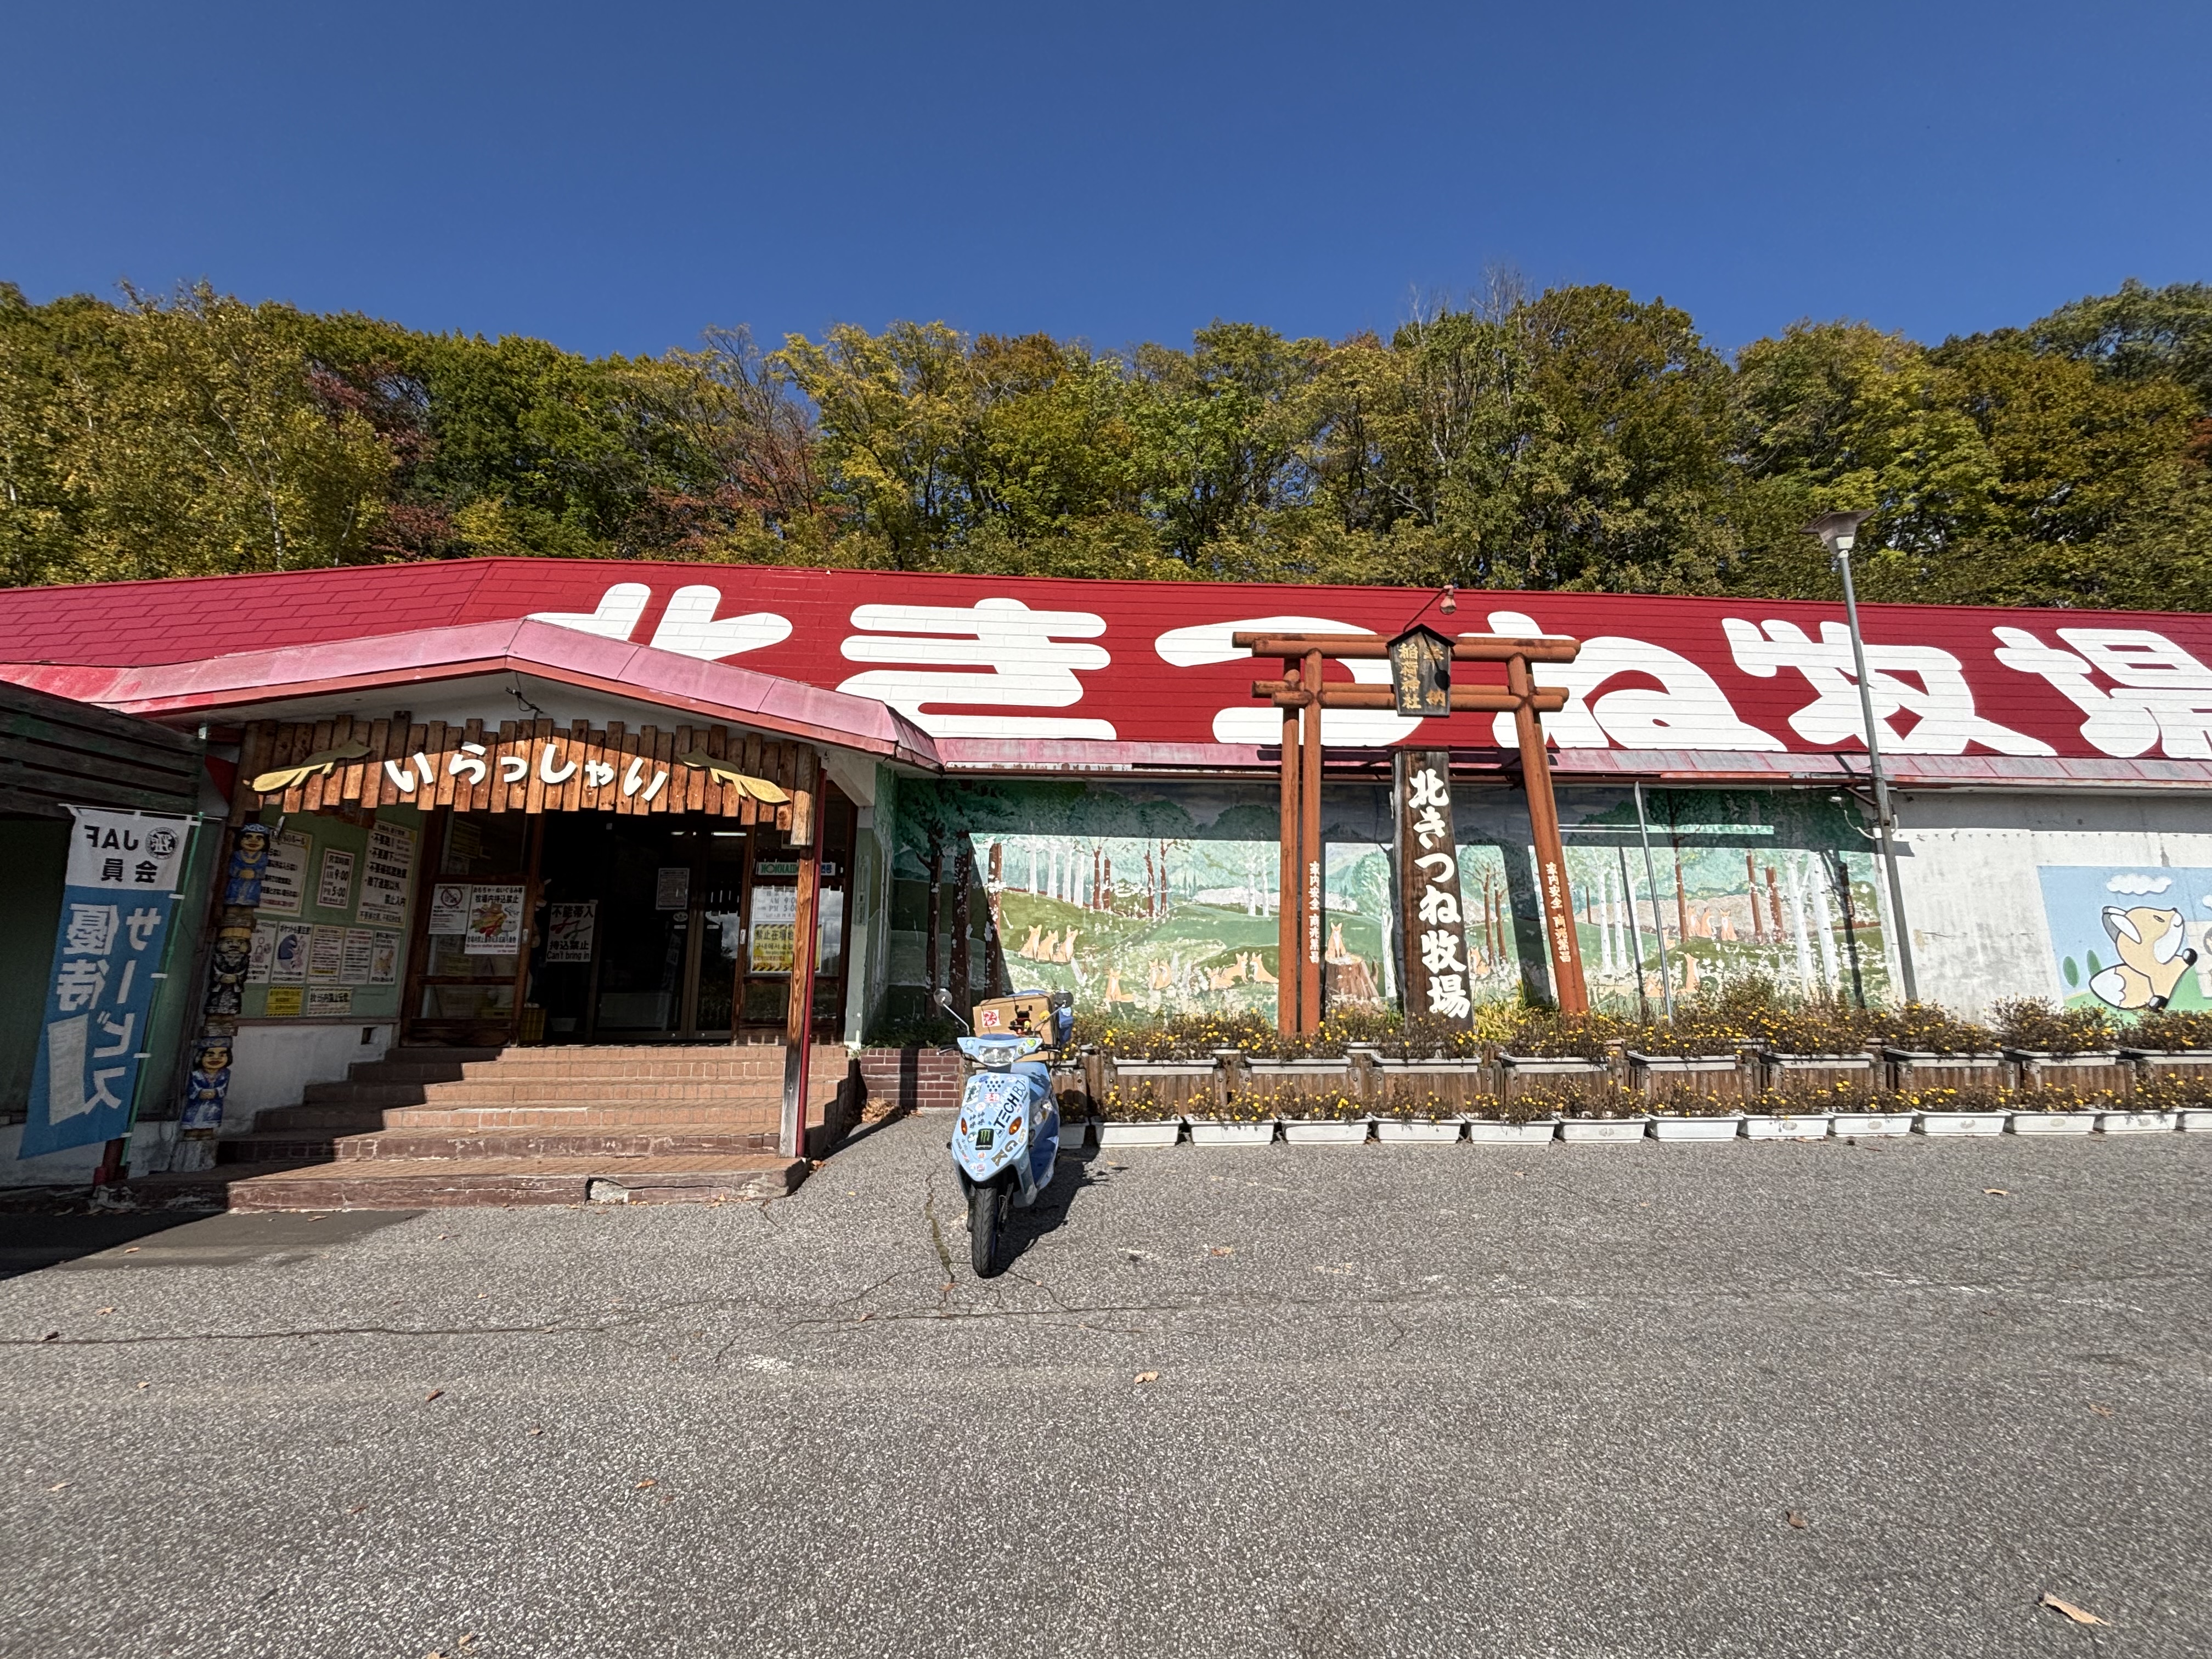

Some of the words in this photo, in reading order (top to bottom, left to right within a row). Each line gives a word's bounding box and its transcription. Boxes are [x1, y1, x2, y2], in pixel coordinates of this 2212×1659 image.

[1398, 642, 1422, 710] 稲荷神社
[385, 742, 668, 802] いらっしゃい
[760, 864, 799, 874] HOKKAID
[1308, 861, 1320, 911] 家内安全
[1545, 861, 1563, 909] 家内安全
[1408, 768, 1471, 1019] 北きつね牧場
[546, 951, 563, 960] Can't
[566, 951, 582, 961] bring
[584, 951, 590, 960] in
[549, 940, 589, 950] 持込禁止
[993, 1092, 1020, 1129] TECH
